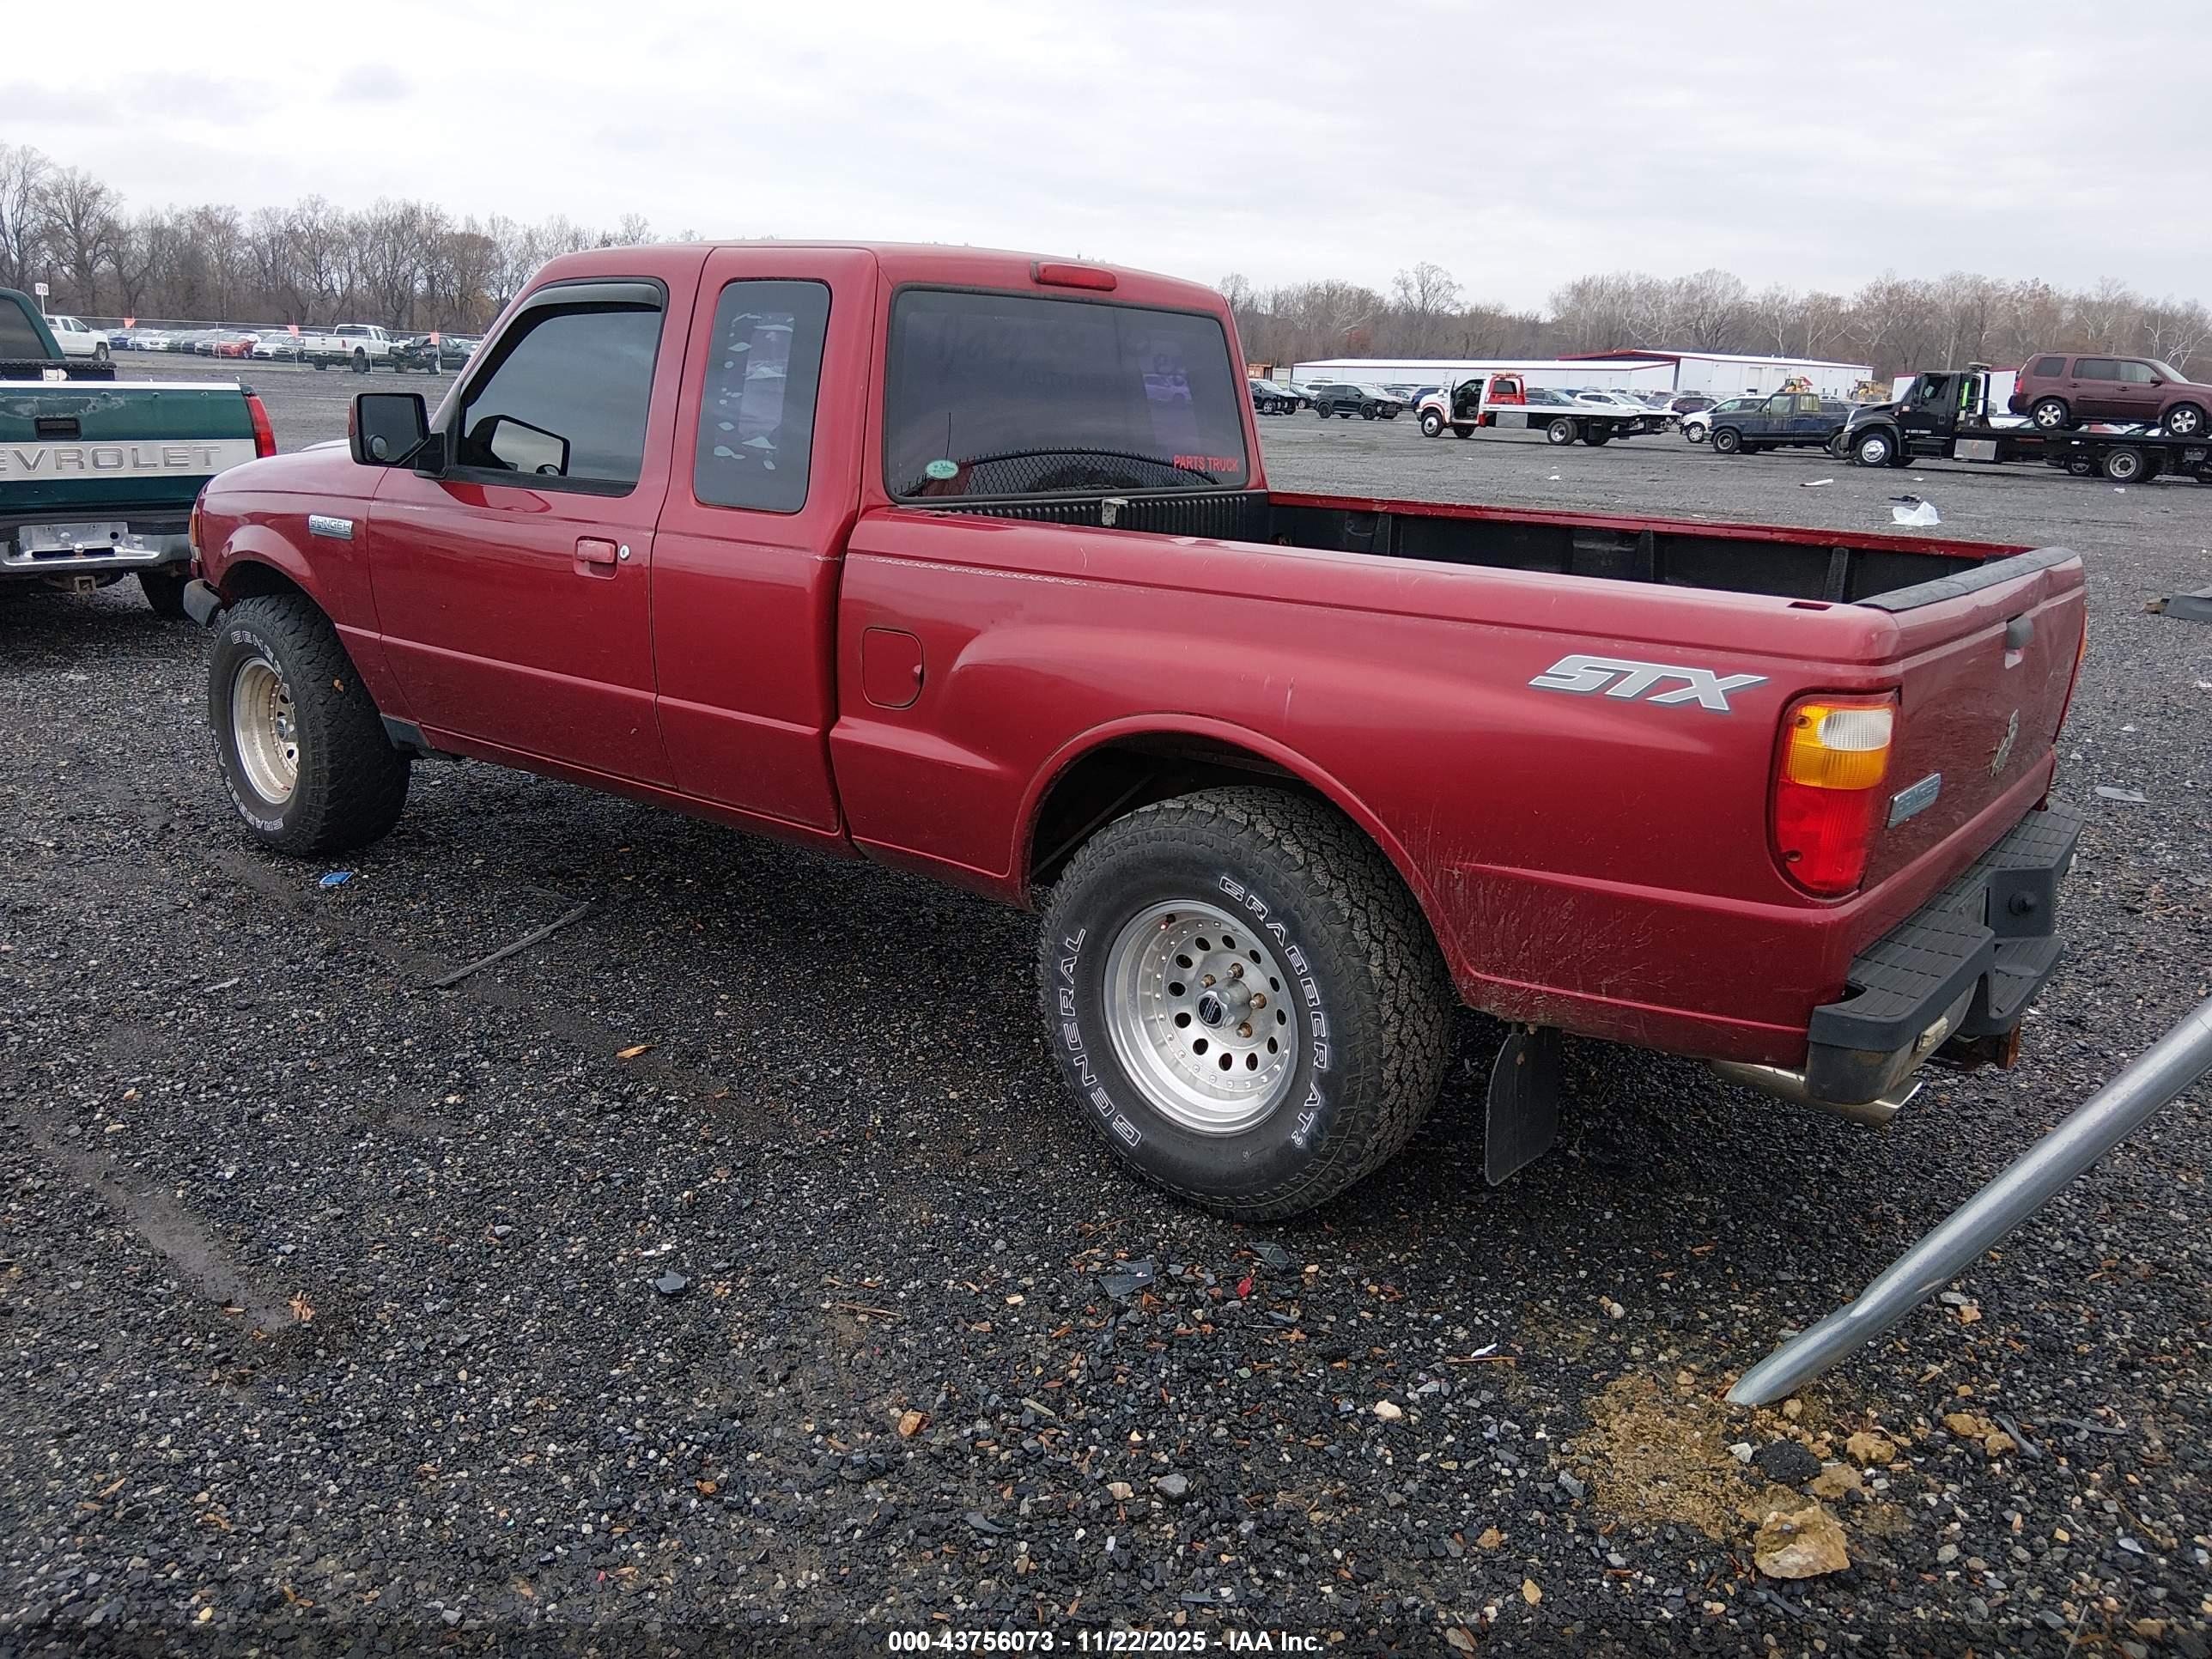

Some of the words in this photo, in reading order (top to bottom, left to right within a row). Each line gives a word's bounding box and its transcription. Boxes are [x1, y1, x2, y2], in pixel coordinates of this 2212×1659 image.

[36, 285, 48, 294] 70
[0, 445, 222, 473] VROLET
[1173, 453, 1205, 471] PARTS
[1206, 456, 1238, 472] TRUCK
[309, 516, 352, 533] RANGER
[1527, 654, 1770, 712] STX
[1218, 875, 1329, 1070] GRABBER
[1058, 927, 1142, 1148] GENERAL
